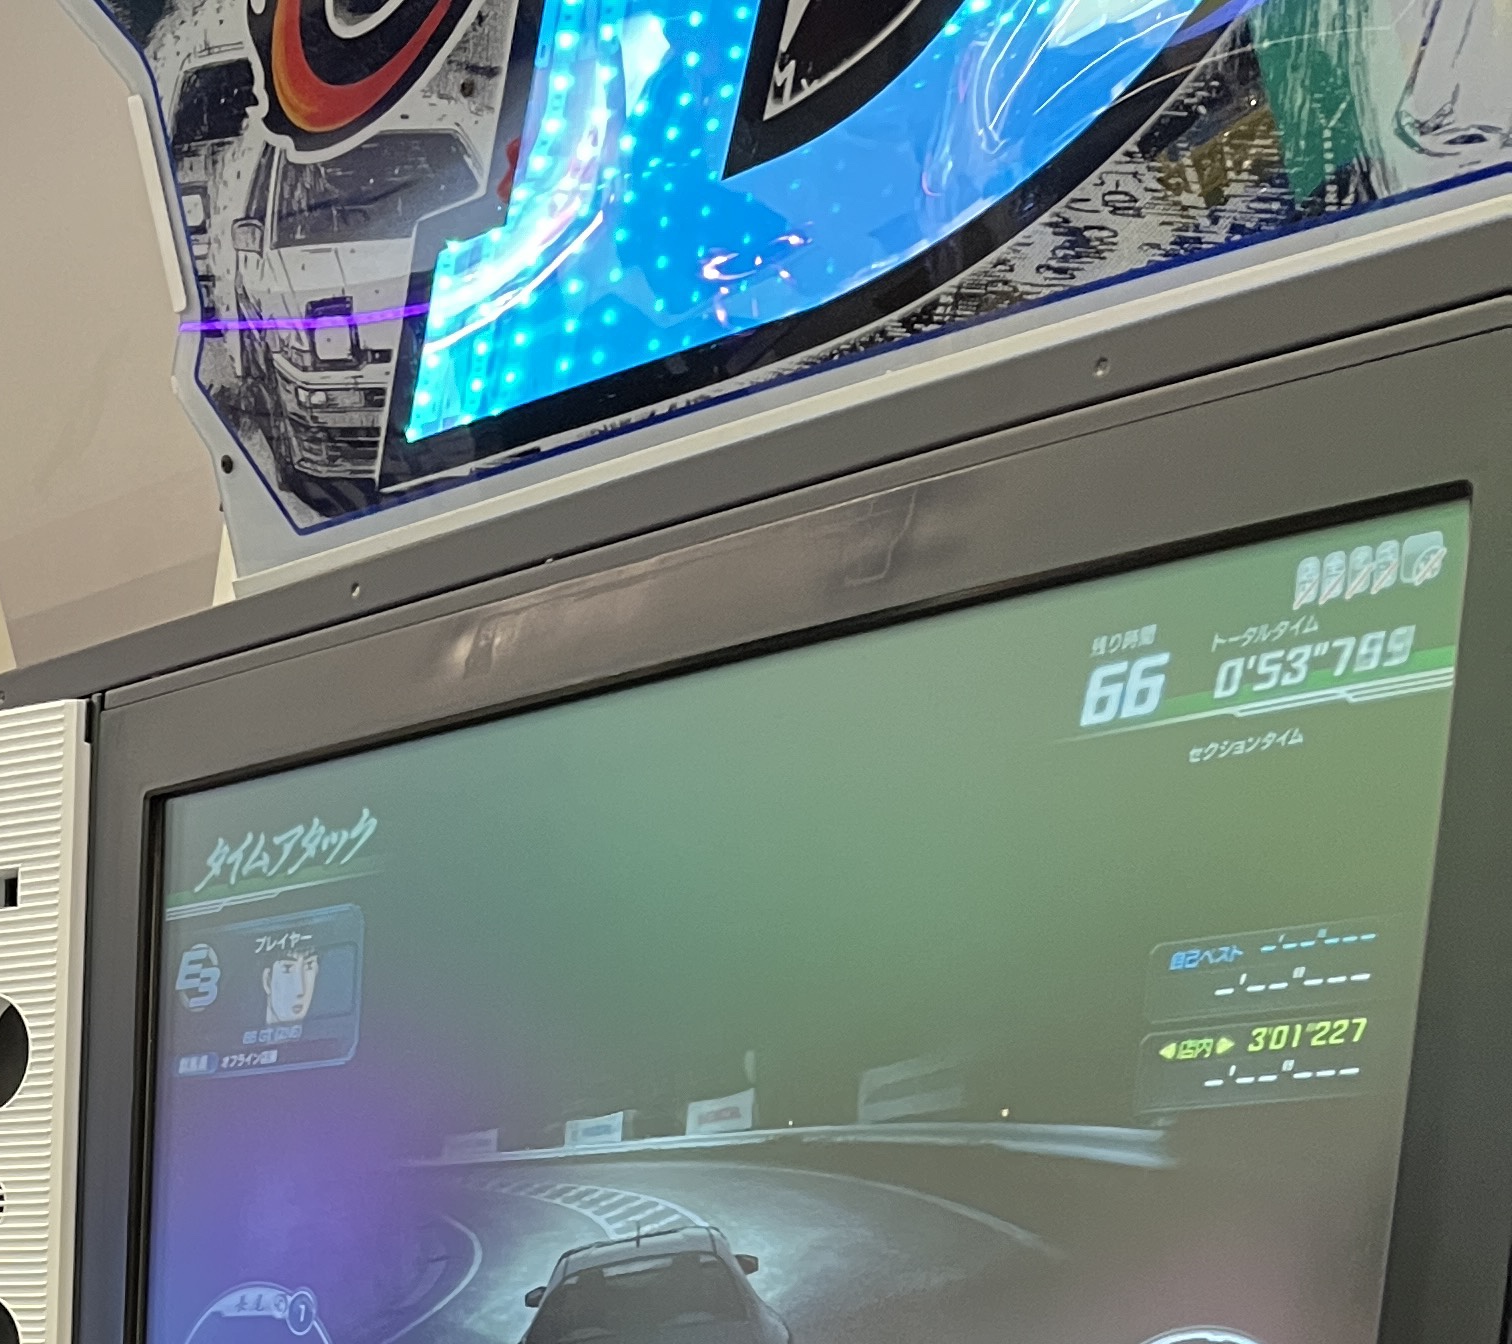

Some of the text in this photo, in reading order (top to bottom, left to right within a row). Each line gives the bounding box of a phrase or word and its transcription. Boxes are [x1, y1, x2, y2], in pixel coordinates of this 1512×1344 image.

[1210, 615, 1320, 653] トータルタイム
[1079, 651, 1171, 728] 66
[1188, 727, 1303, 764] セクションタイム
[194, 807, 378, 894] タイムアタック
[254, 932, 313, 954] プレイヤー
[1168, 945, 1244, 971] 自己ベスト
